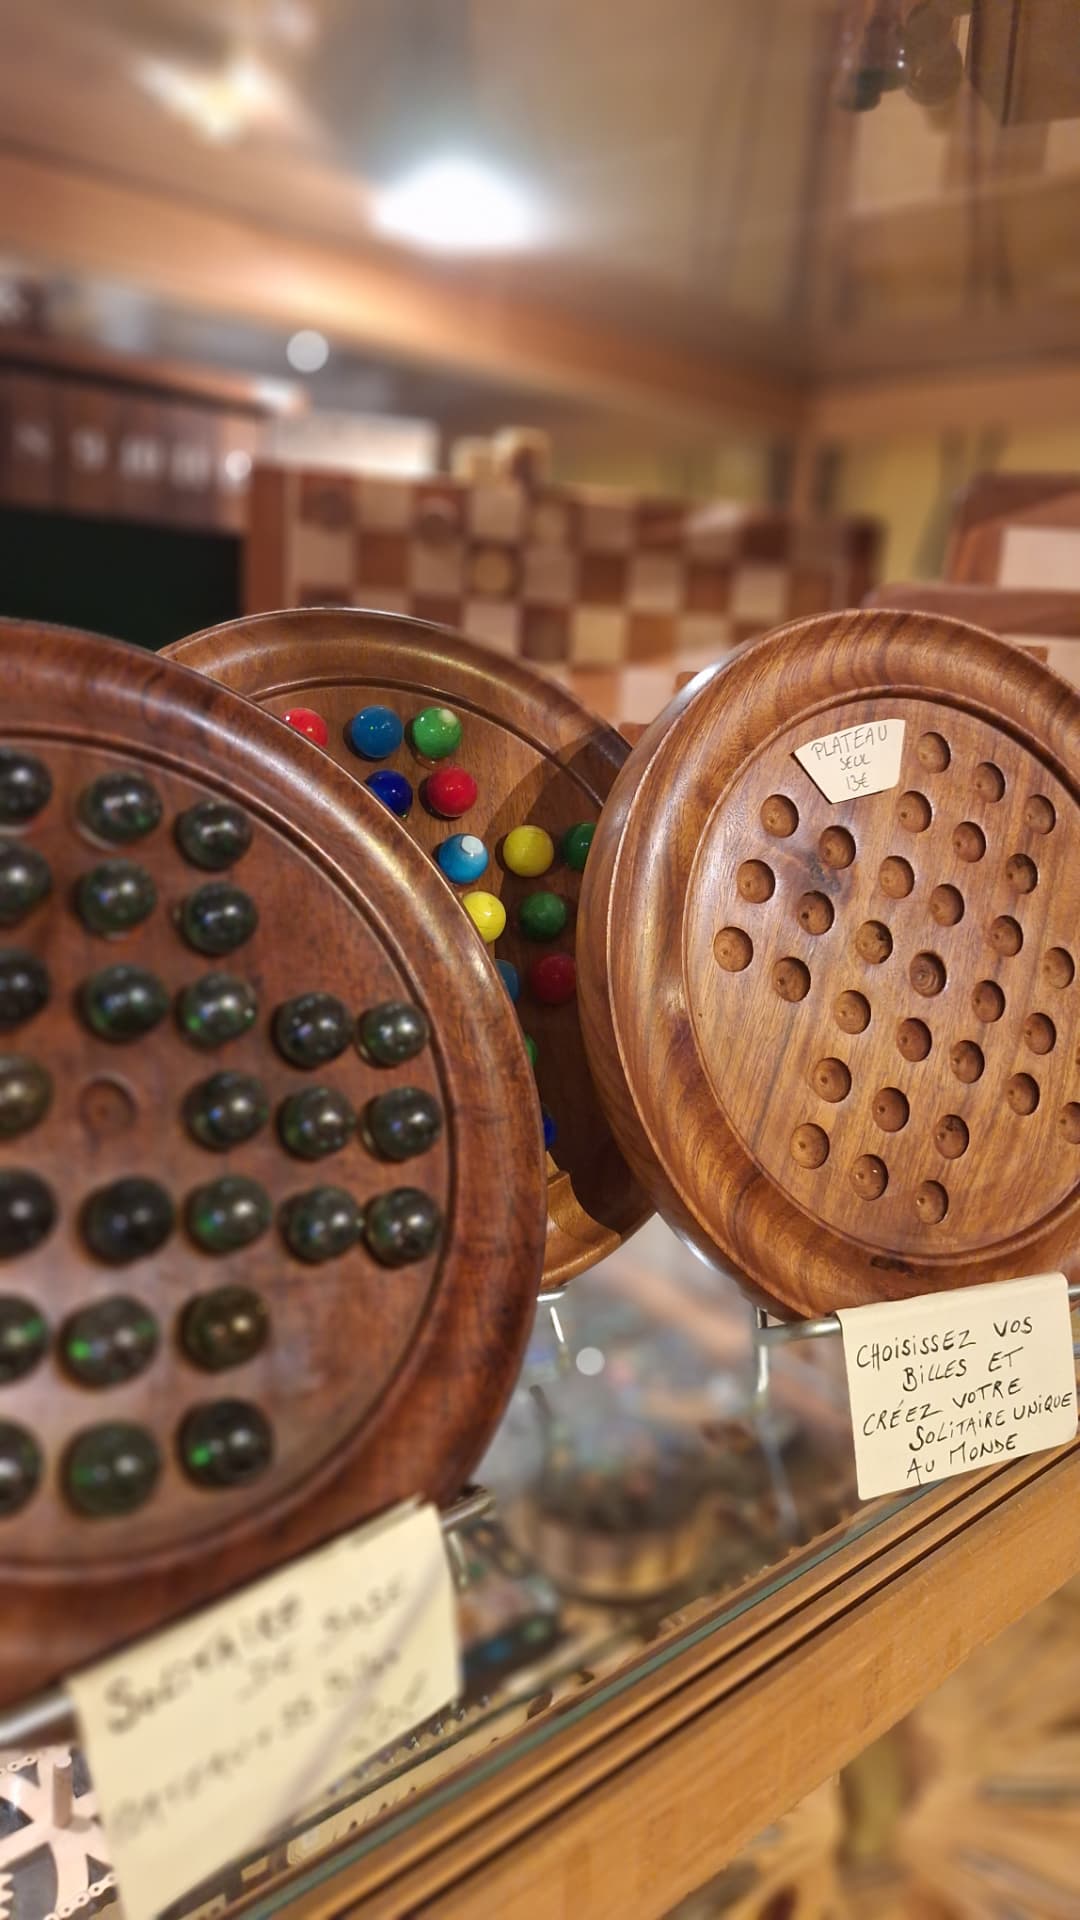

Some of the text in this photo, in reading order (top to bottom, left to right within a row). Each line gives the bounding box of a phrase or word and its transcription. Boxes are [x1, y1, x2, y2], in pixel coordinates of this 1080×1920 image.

[811, 725, 887, 760] PLATEAU
[993, 1316, 1033, 1337] VOS
[988, 1346, 1024, 1372] ET
[863, 1377, 1023, 1436] CRÉEZ VOTRE
[950, 1433, 1018, 1464] MONDE
